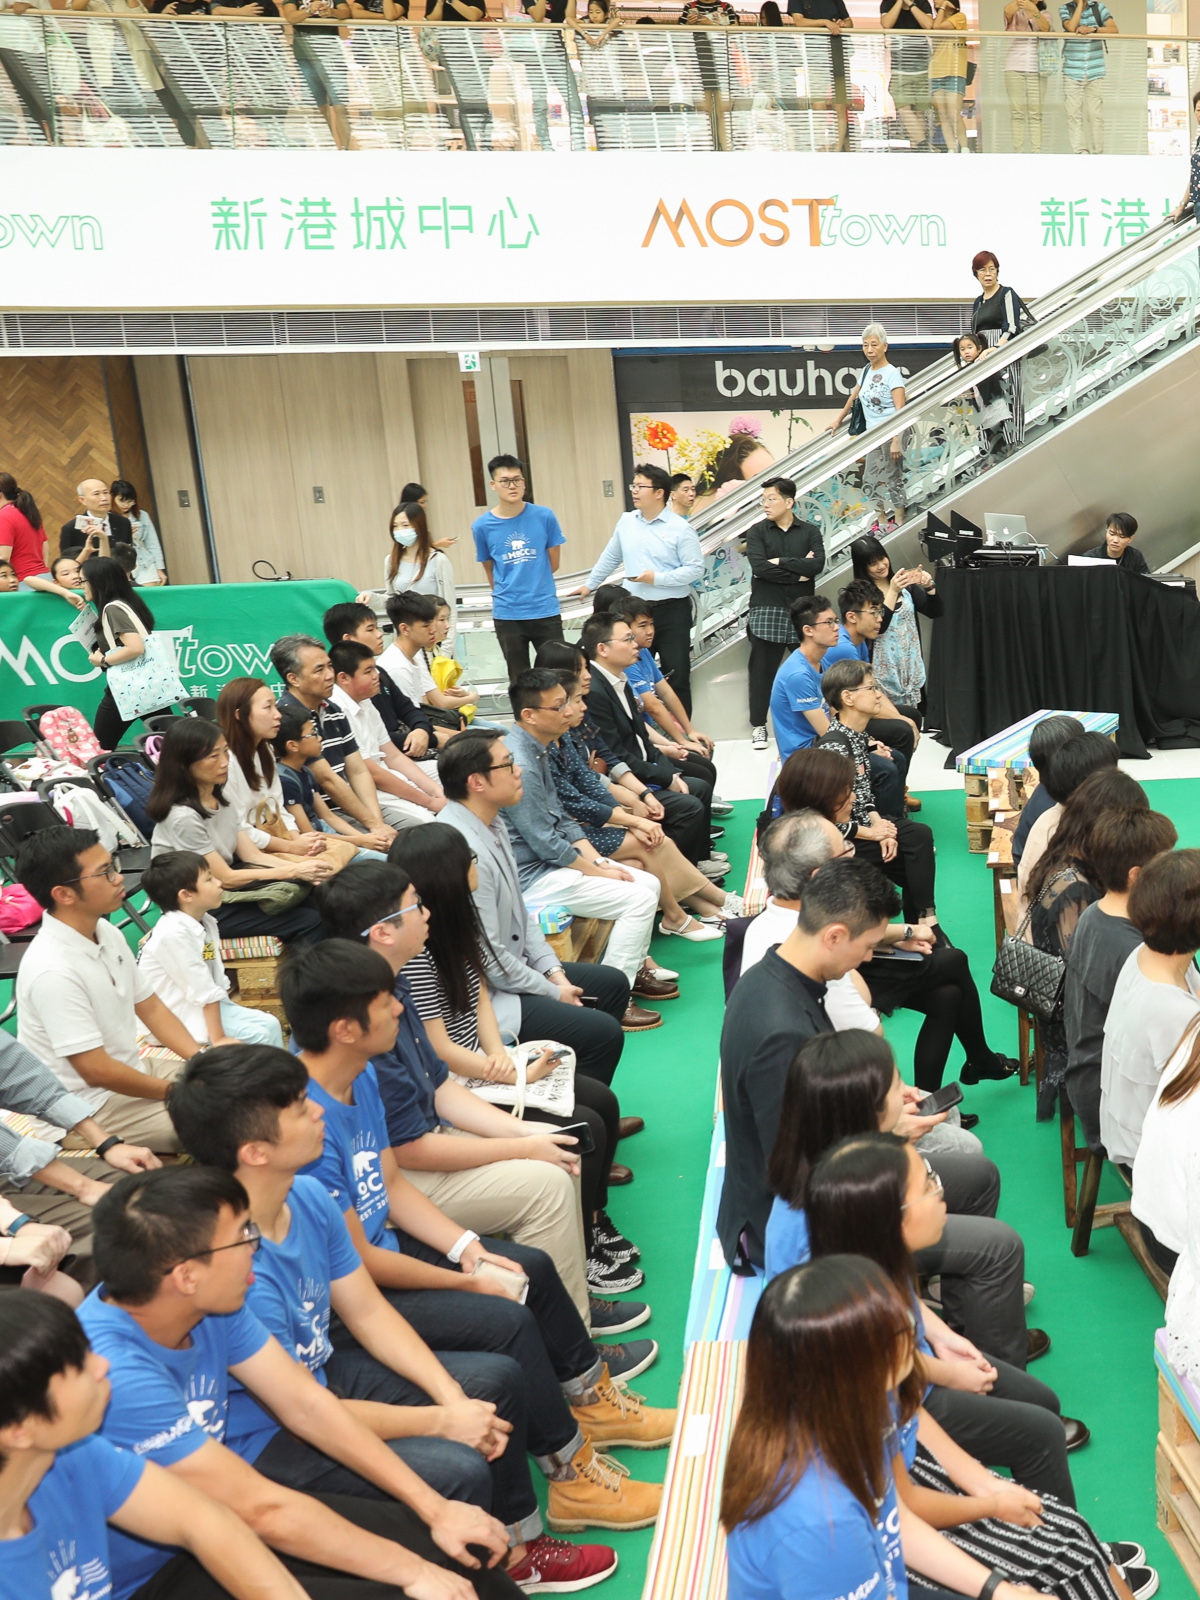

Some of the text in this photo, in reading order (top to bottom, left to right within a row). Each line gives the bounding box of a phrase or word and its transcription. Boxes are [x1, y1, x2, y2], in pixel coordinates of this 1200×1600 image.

[210, 196, 540, 251] 新港城中心
[641, 194, 947, 248] MOST town
[1040, 197, 1186, 246] 新港
[714, 360, 910, 398] bauha
[175, 625, 276, 678] tow
